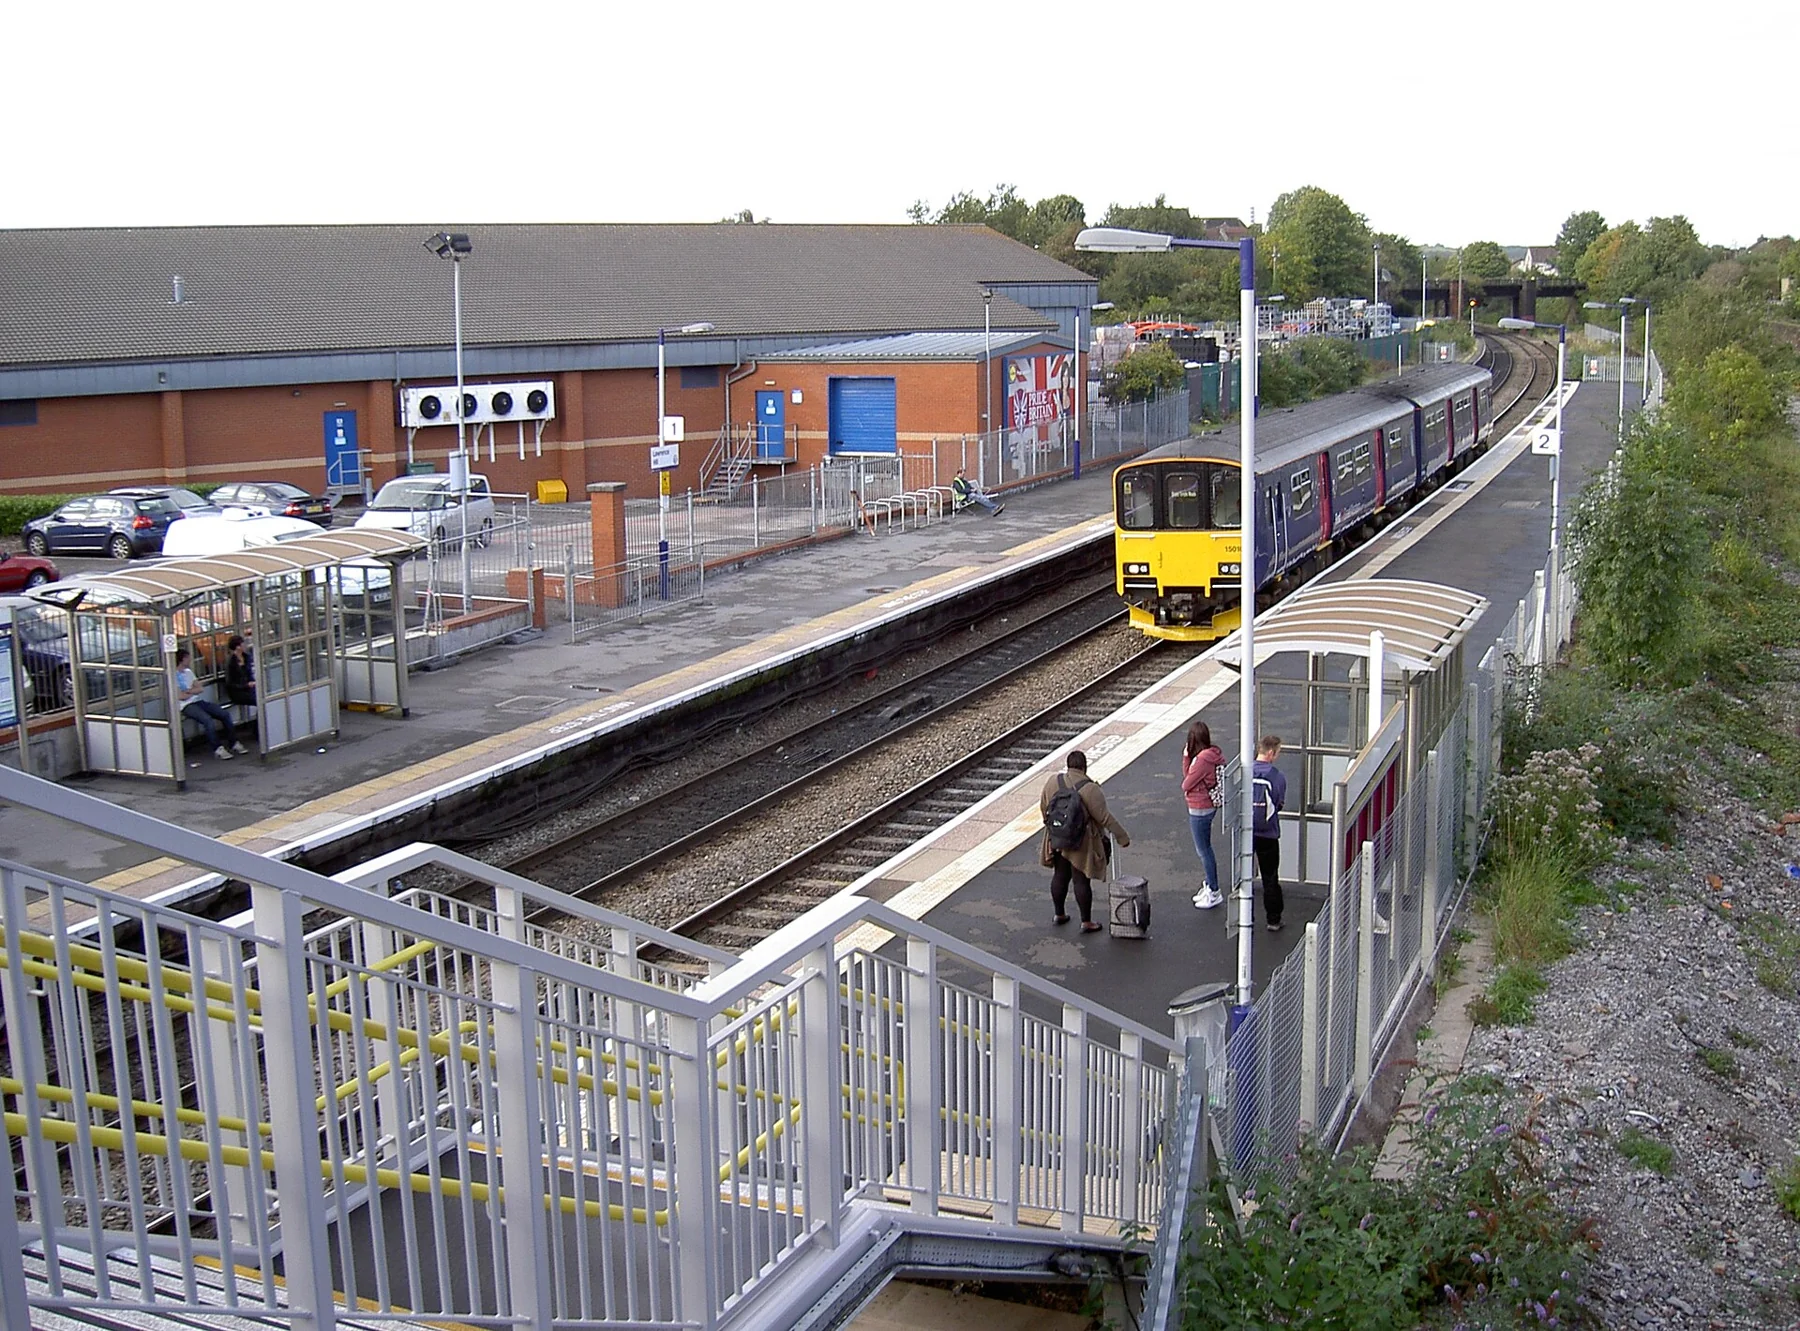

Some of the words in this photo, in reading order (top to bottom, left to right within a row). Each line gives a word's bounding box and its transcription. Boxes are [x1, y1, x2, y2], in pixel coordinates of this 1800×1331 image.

[1028, 391, 1047, 406] PRIDE
[1028, 403, 1054, 420] BRITAIN
[672, 422, 677, 436] 1
[1539, 434, 1550, 449] 2
